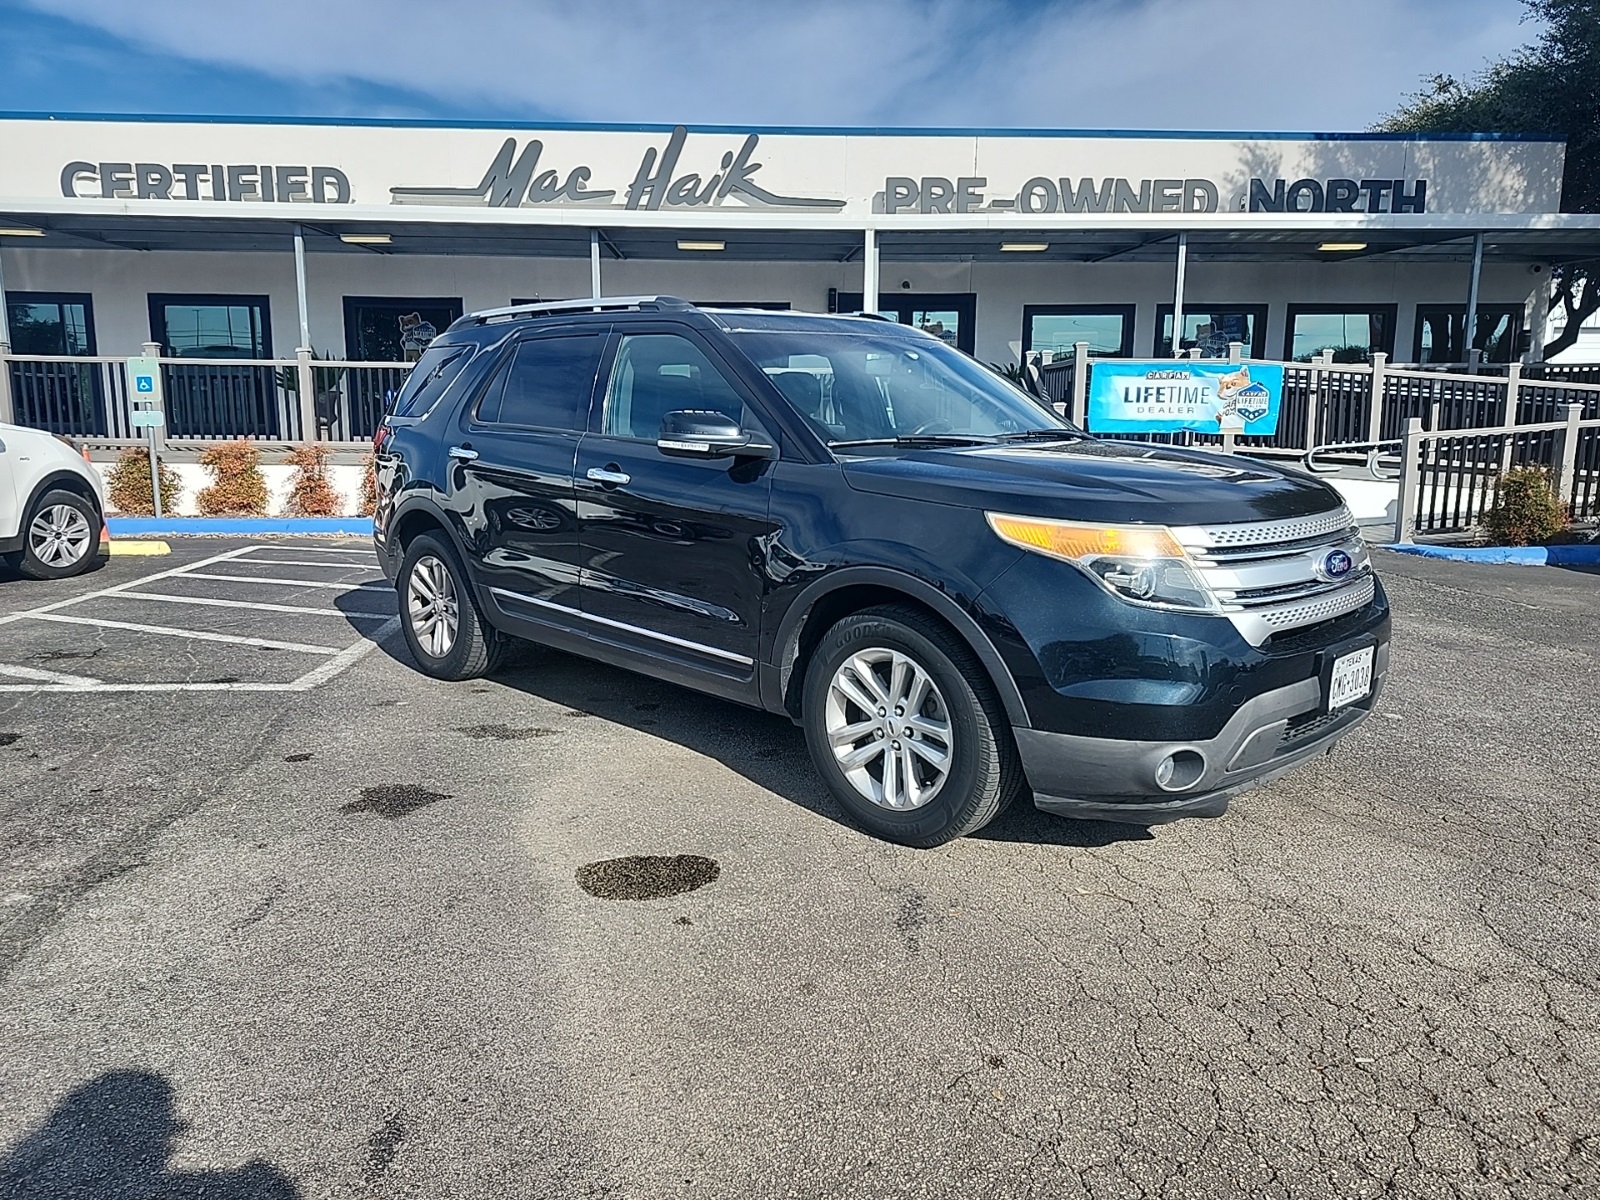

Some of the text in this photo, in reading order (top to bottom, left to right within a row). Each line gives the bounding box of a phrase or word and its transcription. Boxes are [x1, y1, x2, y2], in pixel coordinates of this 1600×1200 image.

[470, 125, 785, 211] Mac Haik
[61, 161, 350, 204] CERTIFIED
[885, 176, 1427, 214] PRE-OWNED NORTH
[1146, 371, 1190, 380] CARFAX
[1123, 386, 1210, 404] LIFETIME
[1237, 397, 1268, 405] LIFETIME
[1137, 406, 1195, 414] DEALER
[1330, 553, 1349, 573] Ford
[1346, 654, 1362, 668] TEXAS
